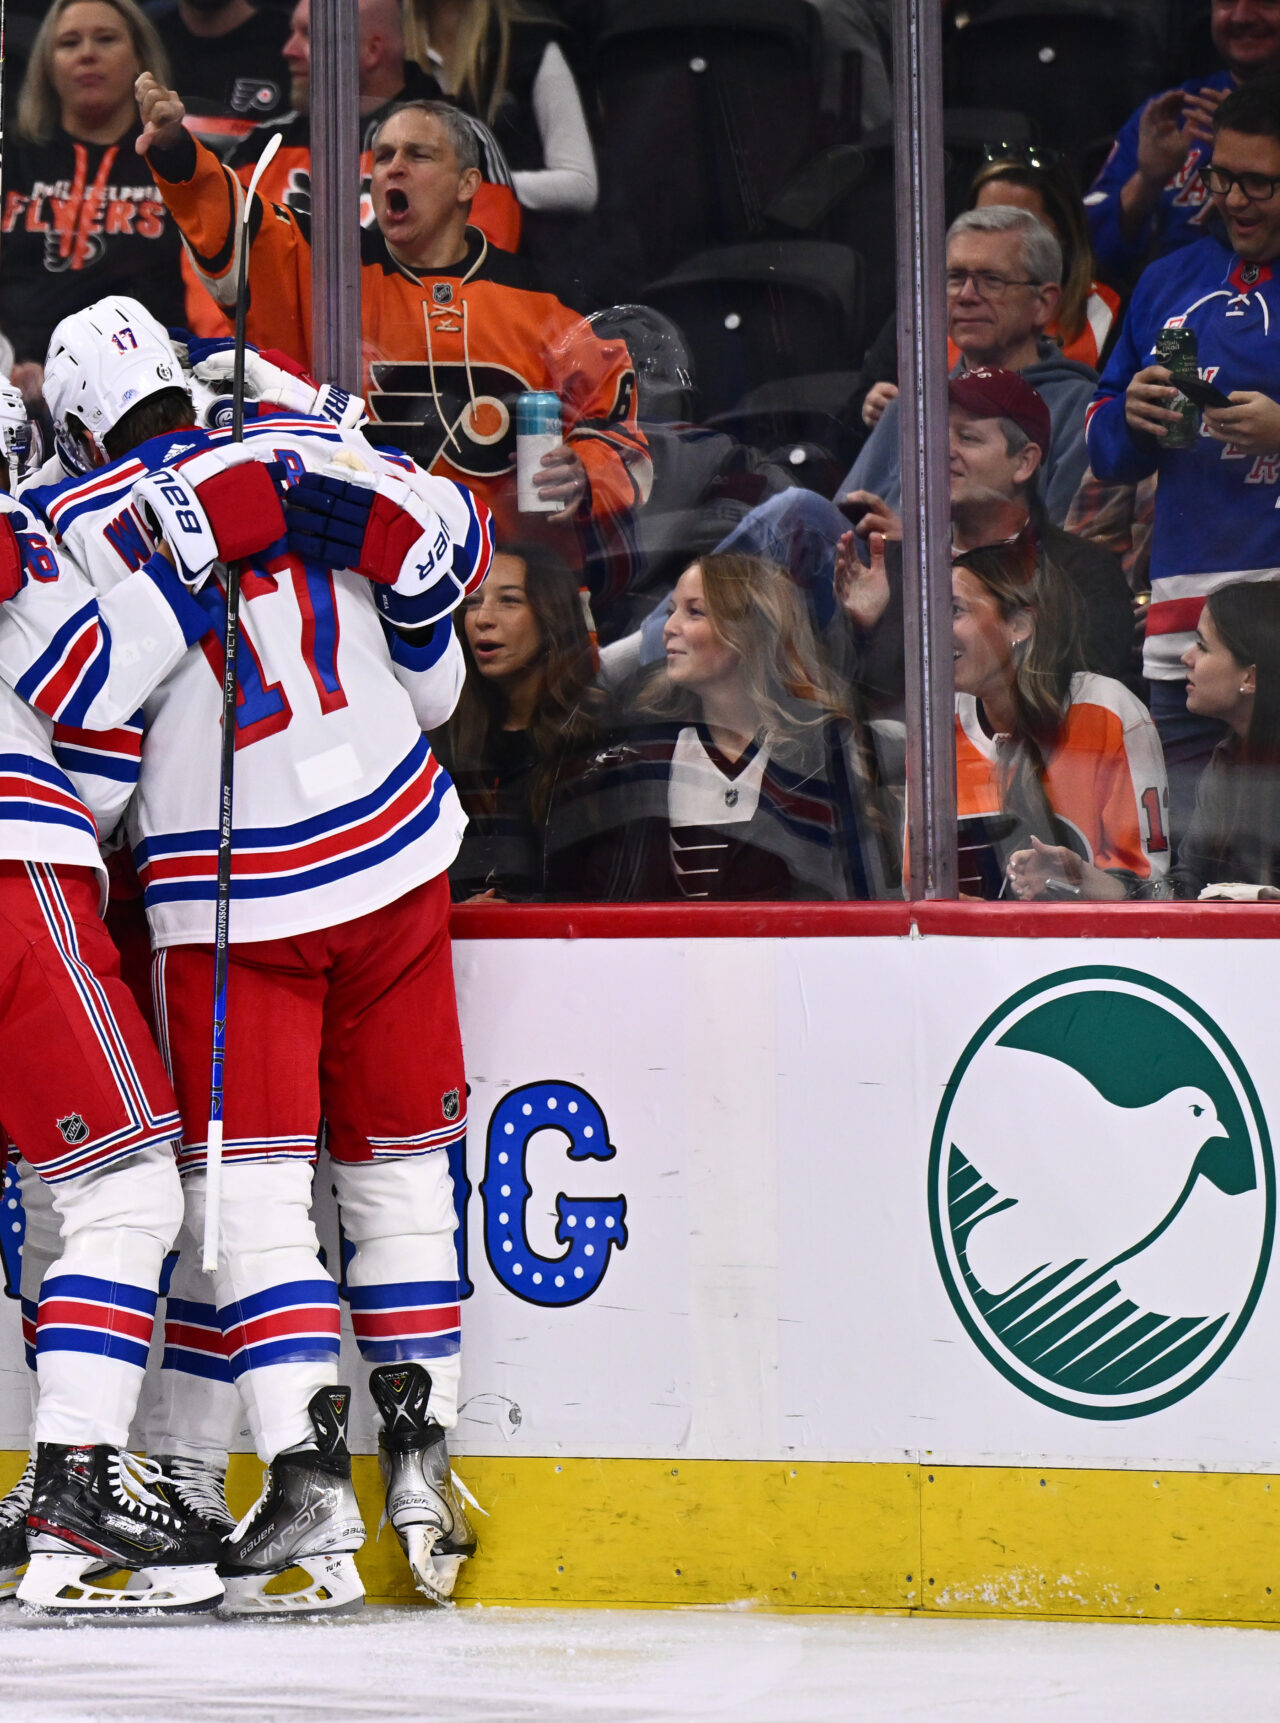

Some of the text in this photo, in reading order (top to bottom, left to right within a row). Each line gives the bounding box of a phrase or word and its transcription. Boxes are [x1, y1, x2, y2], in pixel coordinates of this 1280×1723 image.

[111, 327, 138, 355] 17
[198, 550, 350, 752] 17
[217, 899, 227, 949] GUSTAFSSON
